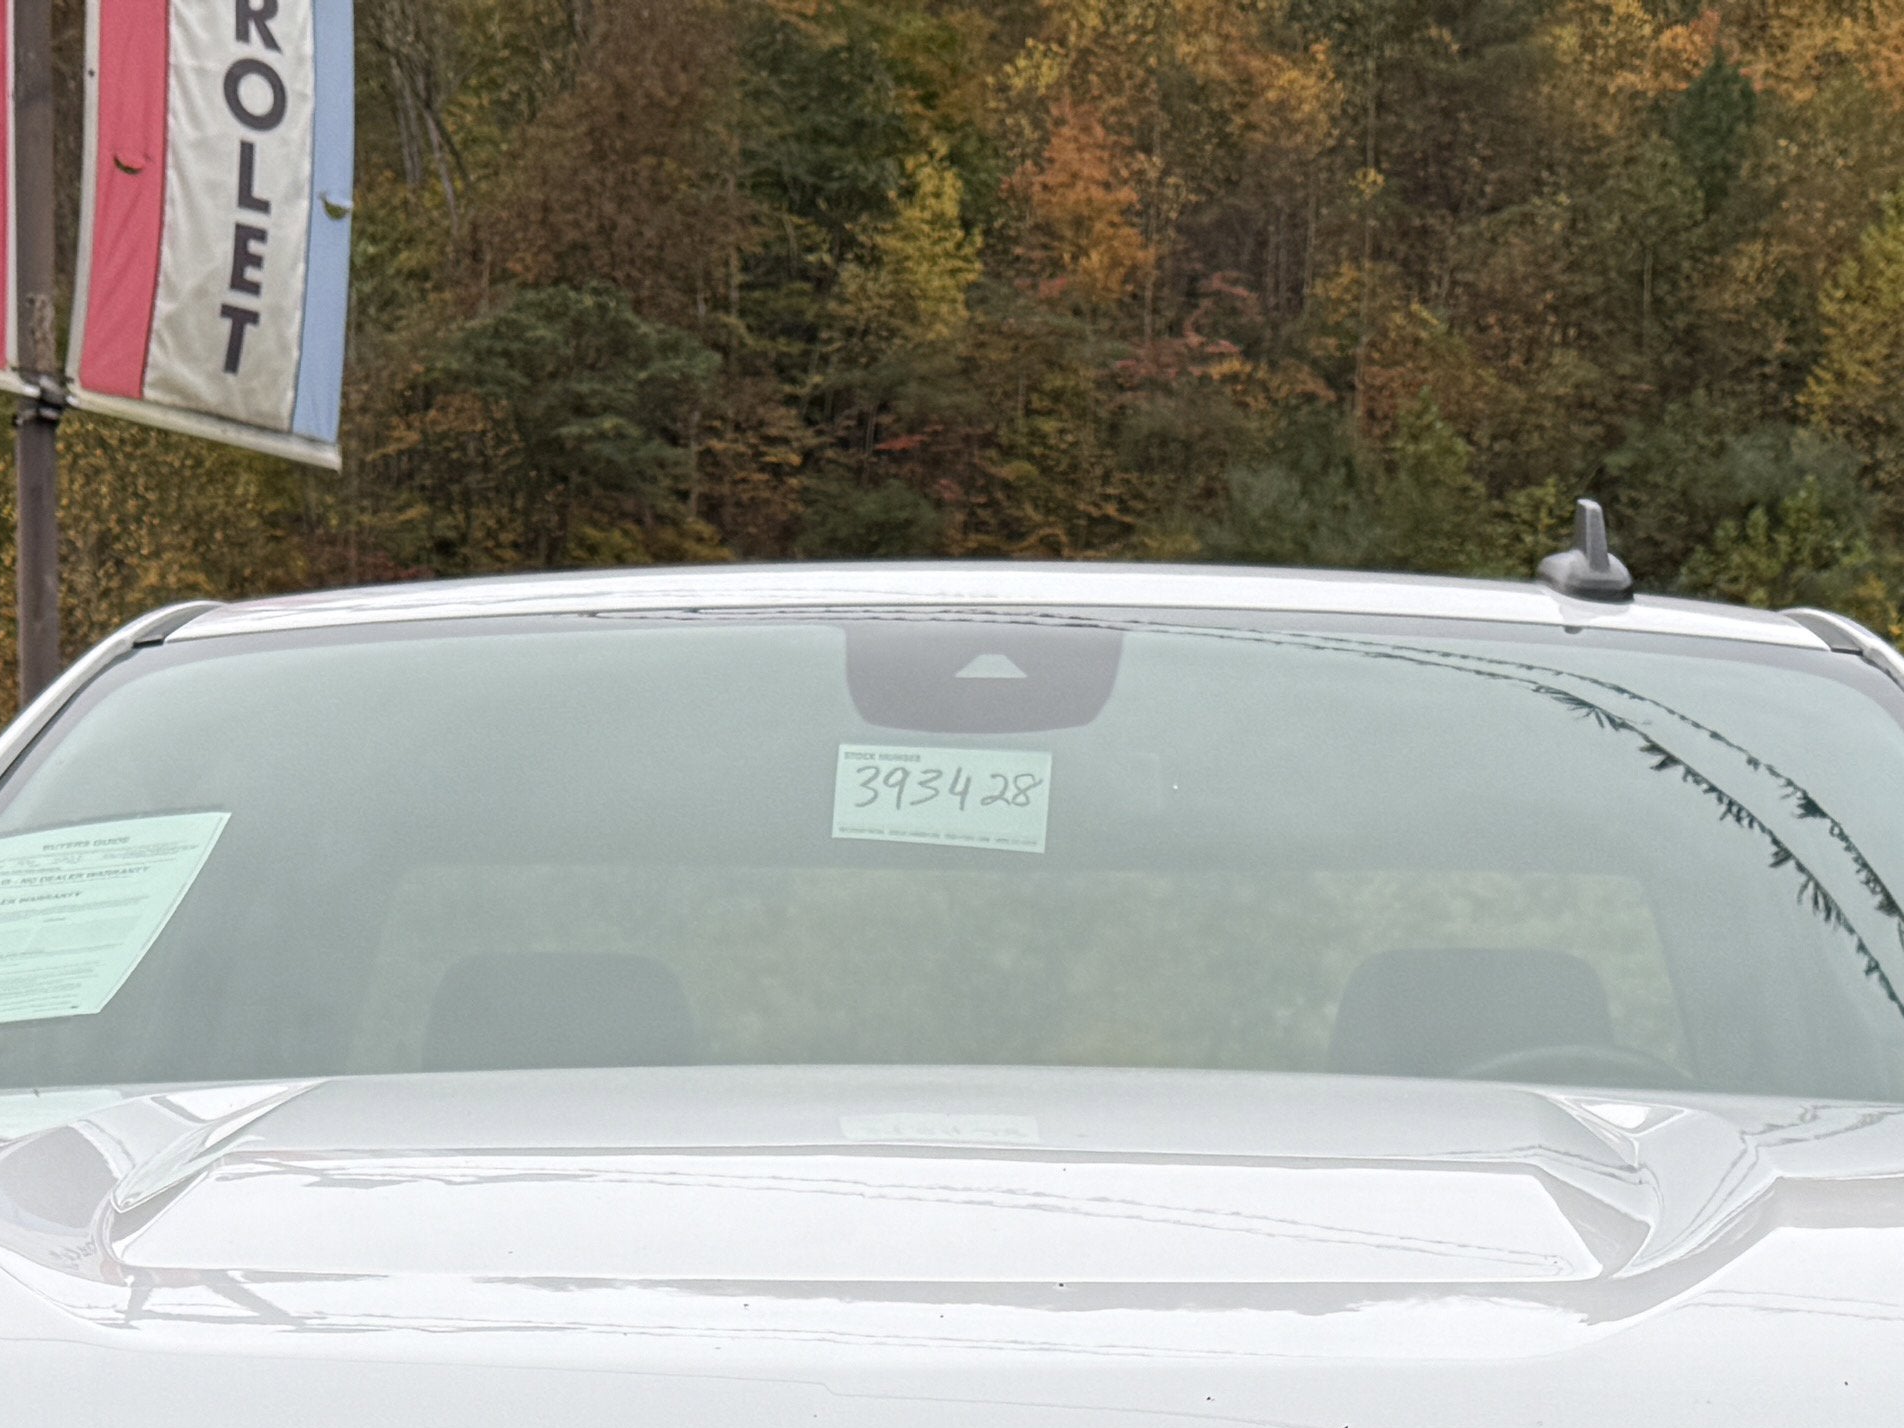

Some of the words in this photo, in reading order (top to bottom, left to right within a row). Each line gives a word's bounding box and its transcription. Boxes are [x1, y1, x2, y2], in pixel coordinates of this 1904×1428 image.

[843, 751, 876, 761] STOCK
[878, 753, 922, 763] NUMBER
[854, 764, 1044, 812] 393428
[92, 835, 131, 848] GUIDE
[39, 871, 85, 884] DEALER
[85, 865, 151, 879] WARRANTY
